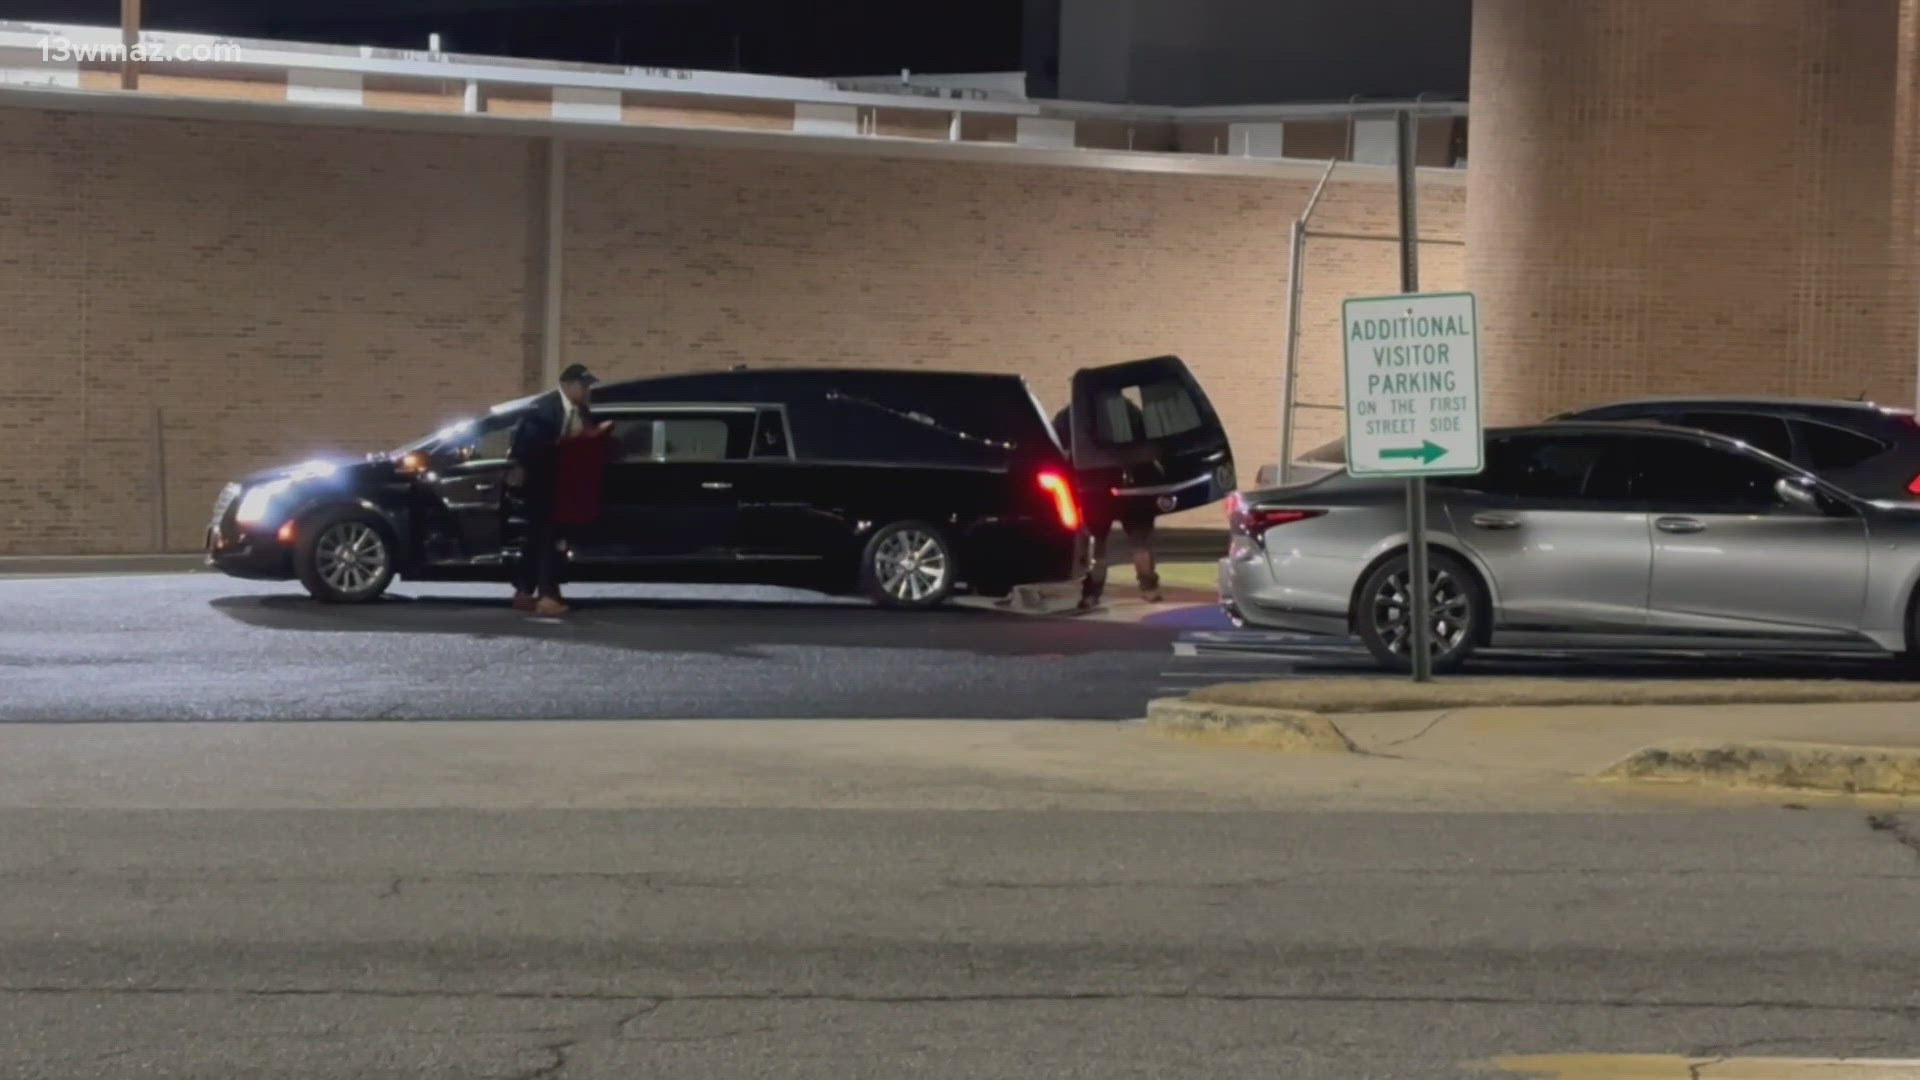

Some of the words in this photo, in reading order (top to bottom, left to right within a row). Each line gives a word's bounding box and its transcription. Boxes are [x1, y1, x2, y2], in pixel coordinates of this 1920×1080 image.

[1351, 315, 1470, 341] ADDITIONAL
[1373, 343, 1449, 367] VISITOR
[1368, 370, 1456, 395] PARKING
[1357, 401, 1377, 416] ON
[1391, 399, 1416, 414] THE
[1430, 396, 1467, 412] FIRST
[1366, 418, 1416, 435] STREET
[1430, 416, 1461, 433] SIDE
